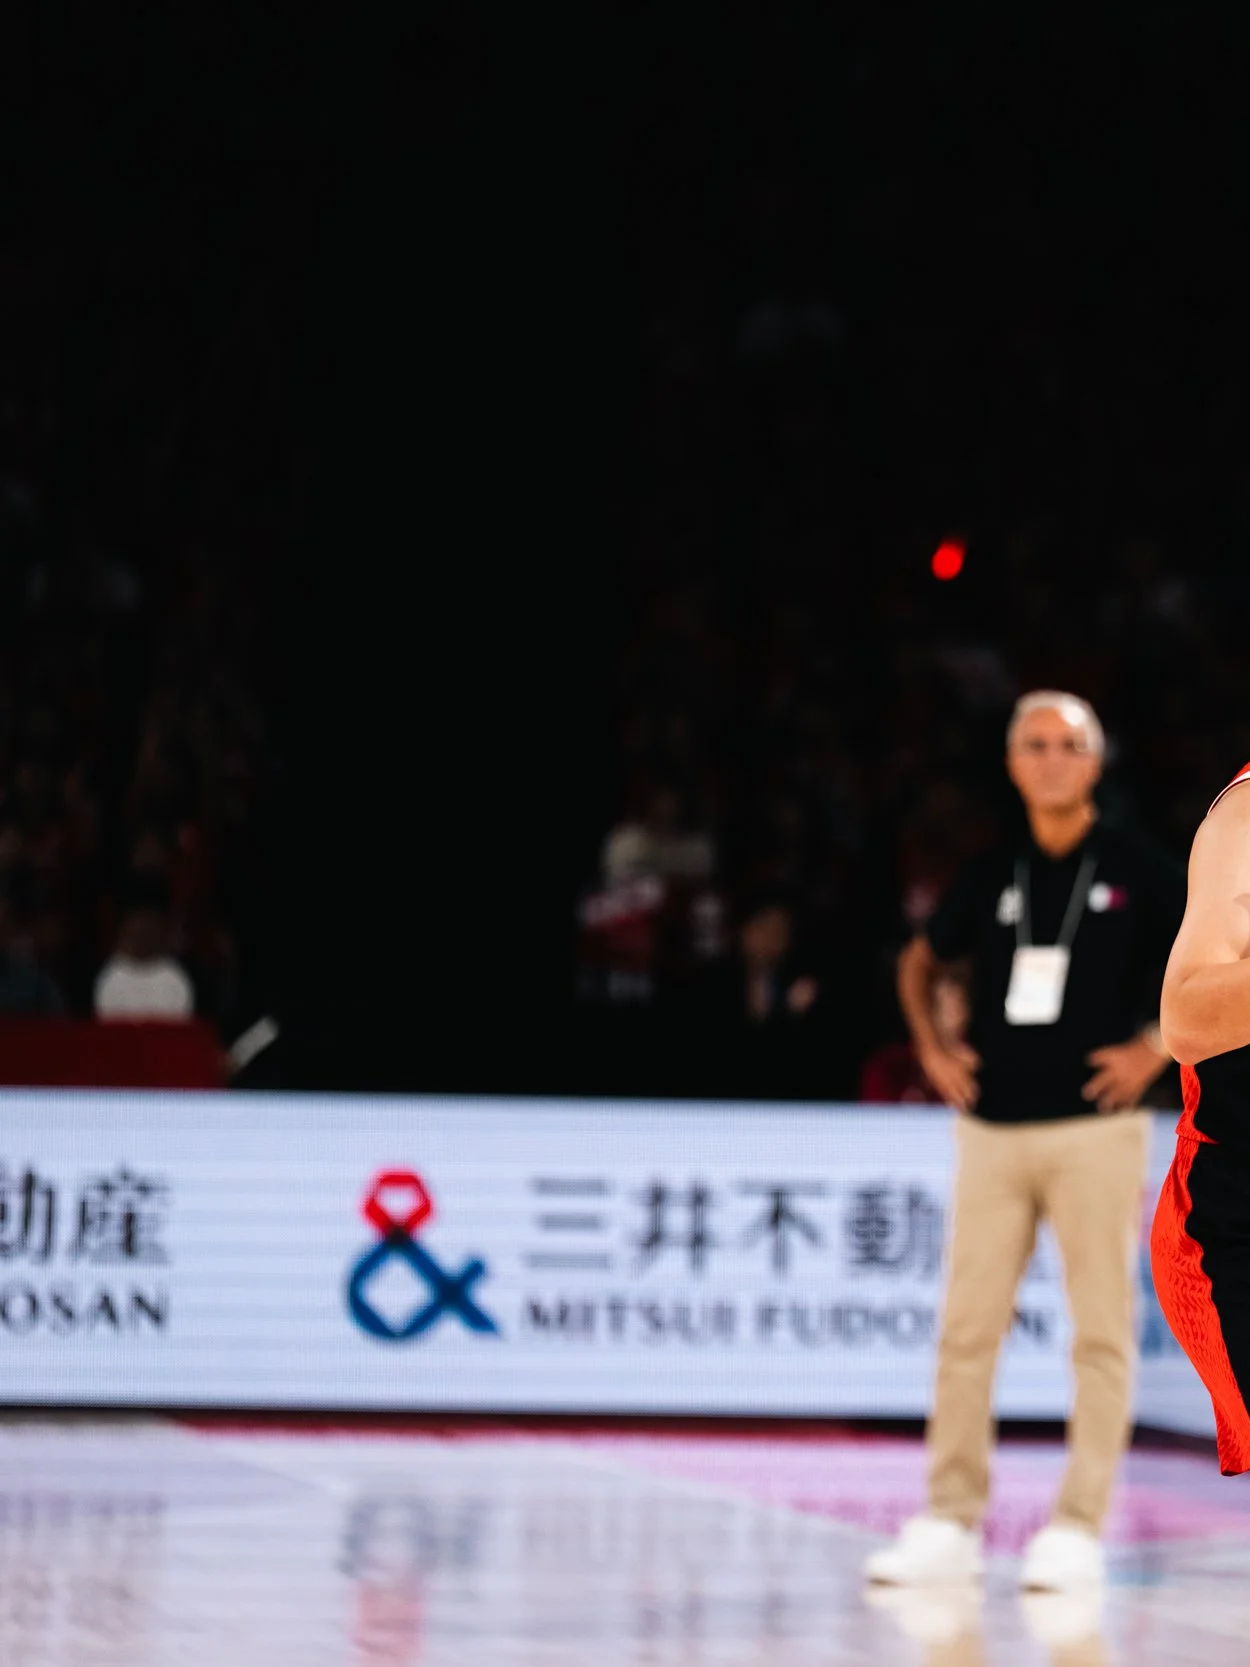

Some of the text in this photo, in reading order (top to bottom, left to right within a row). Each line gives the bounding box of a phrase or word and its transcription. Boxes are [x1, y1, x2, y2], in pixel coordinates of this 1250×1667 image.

[521, 1175, 948, 1282] 三井不動
[0, 1281, 171, 1337] OSAN
